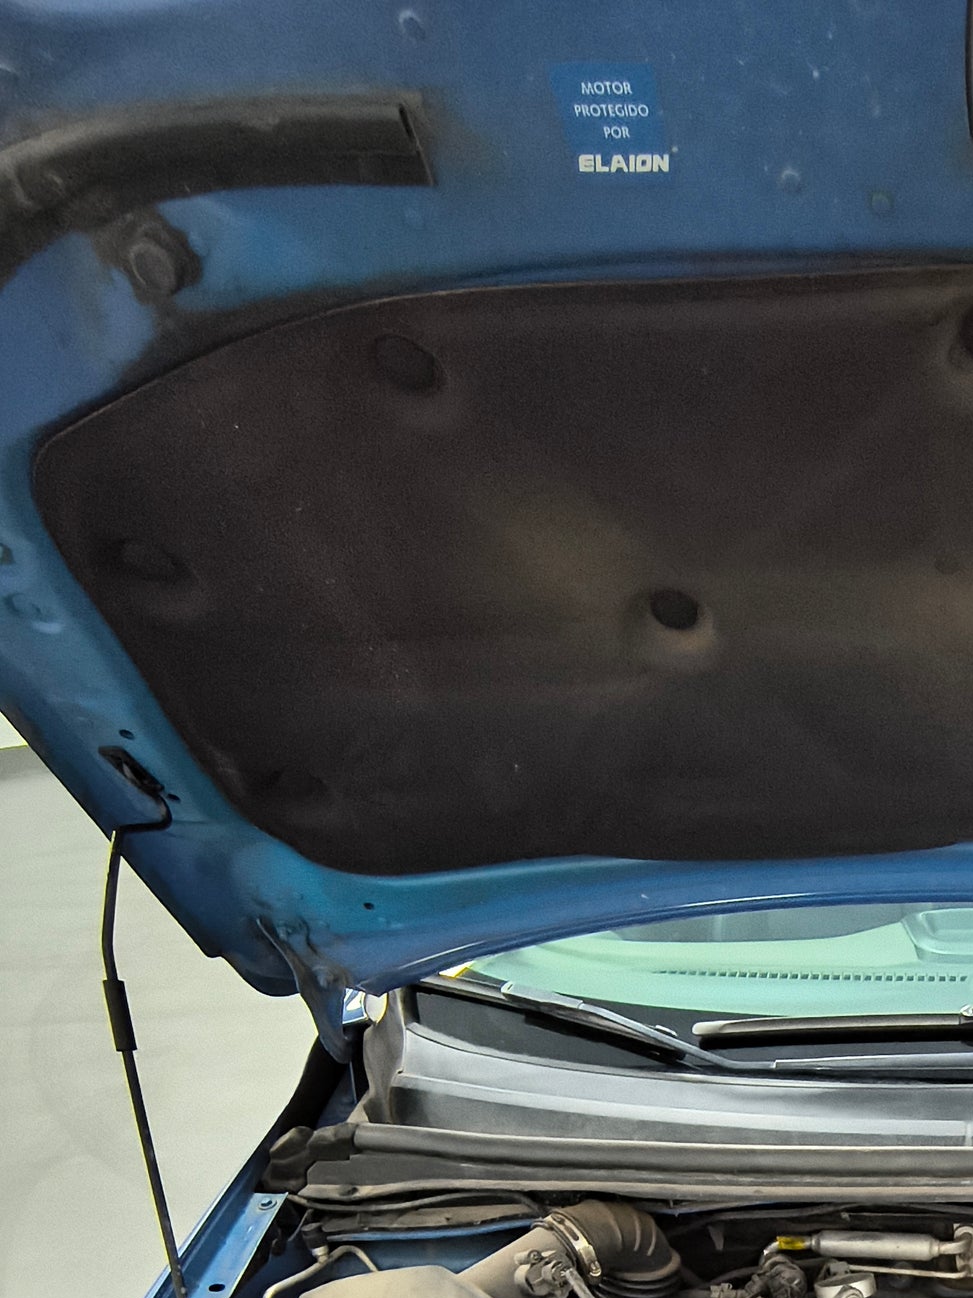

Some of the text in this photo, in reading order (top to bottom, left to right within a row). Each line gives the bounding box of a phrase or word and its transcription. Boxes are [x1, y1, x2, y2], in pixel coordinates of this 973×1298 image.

[581, 81, 633, 95] MOTOR
[574, 104, 649, 118] PROTEGIDO
[603, 126, 631, 139] POR
[578, 154, 670, 173] ELAION
